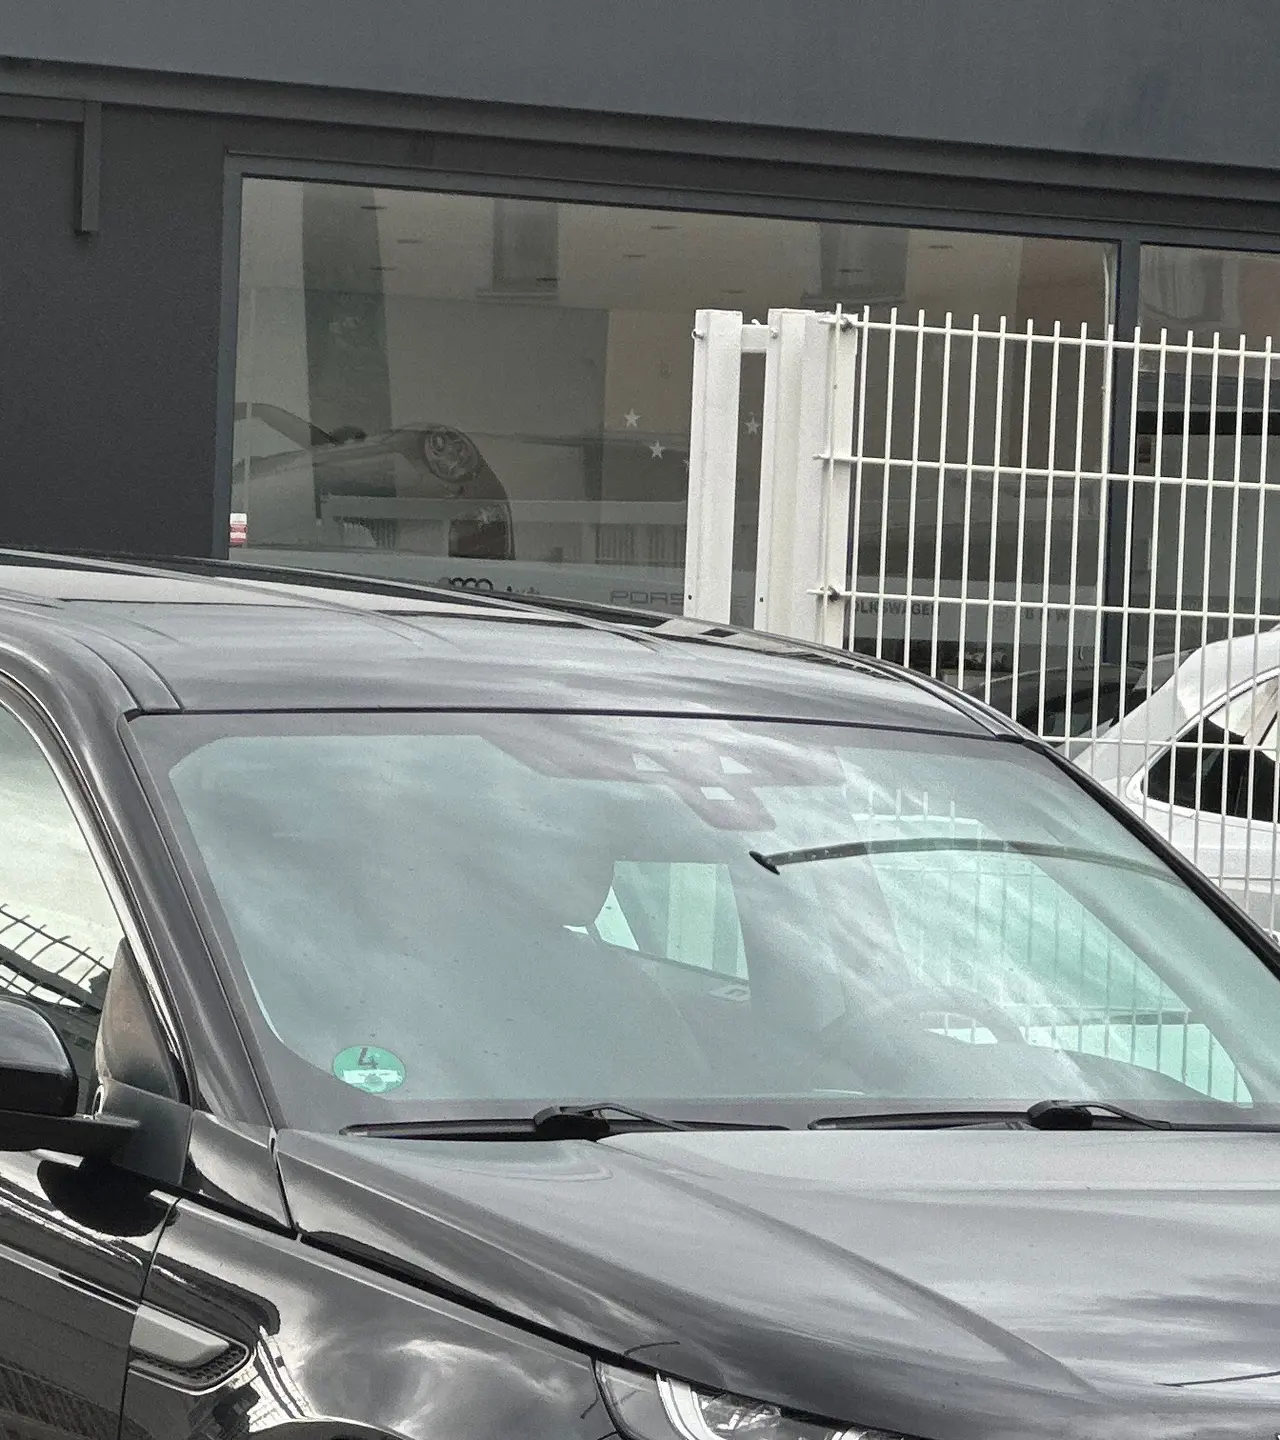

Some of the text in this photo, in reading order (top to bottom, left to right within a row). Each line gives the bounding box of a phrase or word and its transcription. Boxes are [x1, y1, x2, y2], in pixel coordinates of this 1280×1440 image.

[610, 591, 747, 607] PORSE
[846, 600, 941, 616] OLKSWGEN
[358, 1047, 378, 1070] 4
